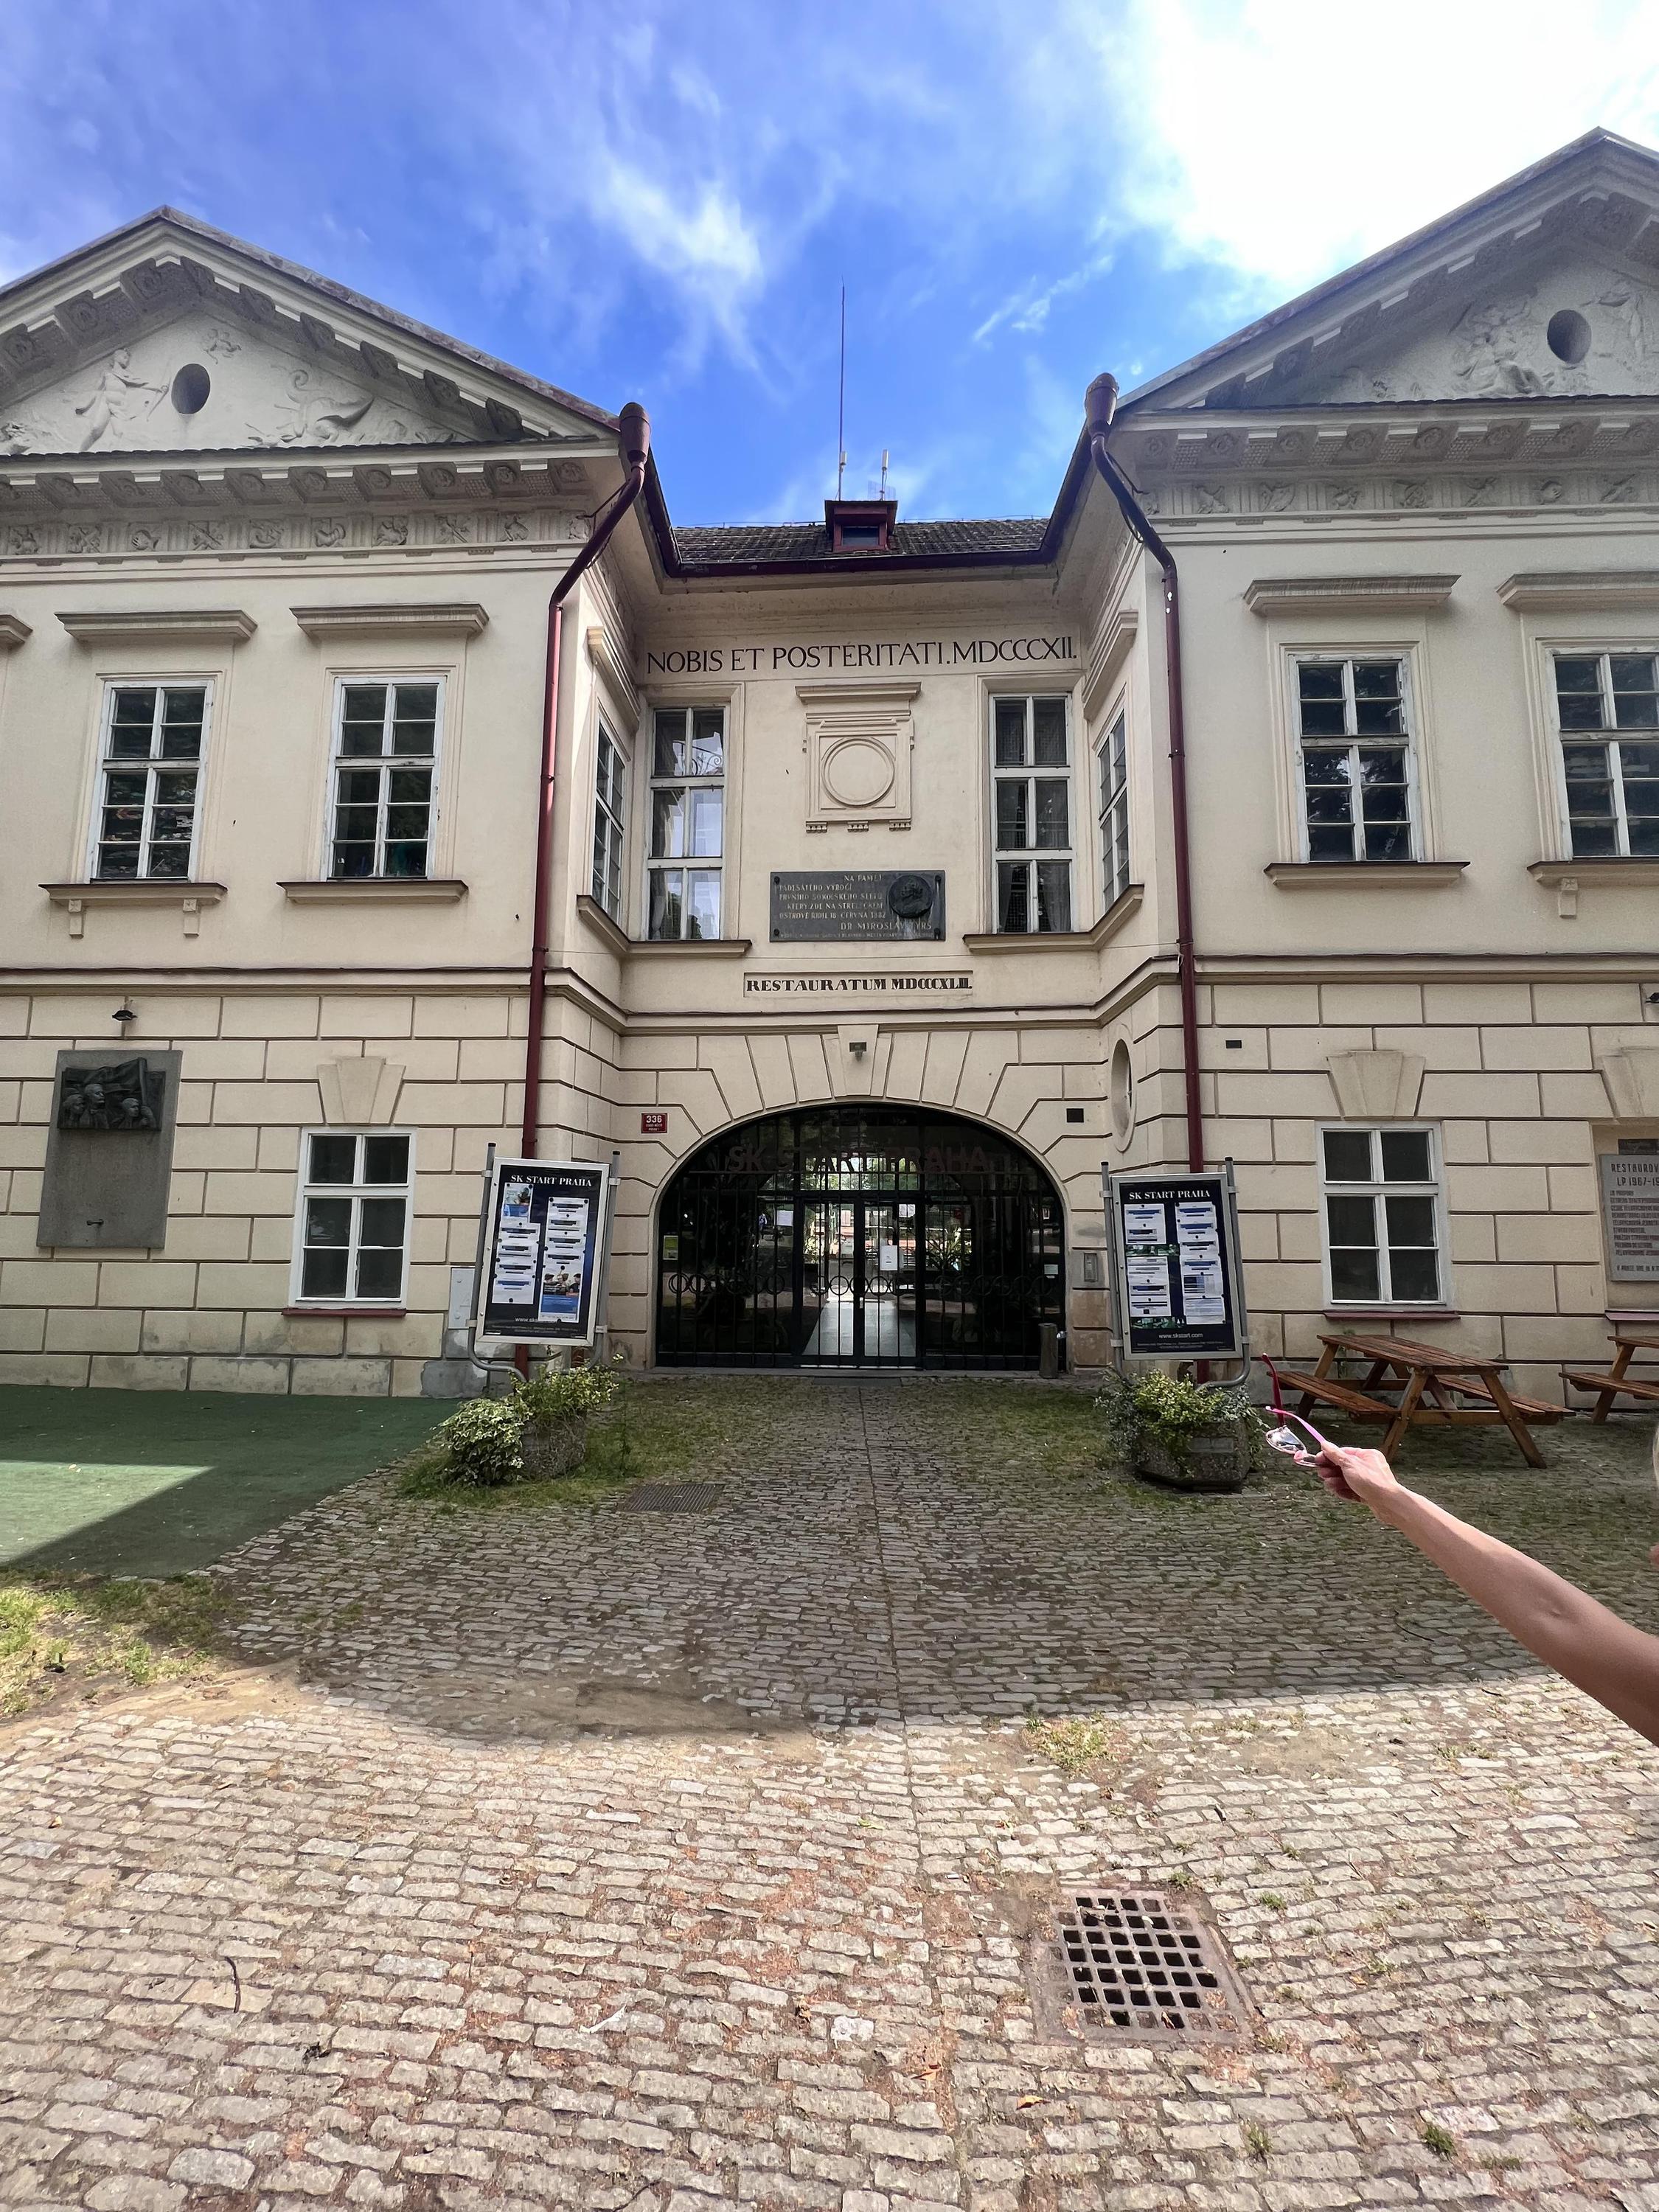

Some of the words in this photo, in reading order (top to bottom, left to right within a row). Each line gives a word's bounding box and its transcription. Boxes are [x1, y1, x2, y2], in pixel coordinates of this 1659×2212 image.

[647, 650, 723, 674] NOBIS
[731, 648, 765, 671] ET
[746, 978, 887, 992] RESTAURATUM
[646, 1115, 662, 1124] 336
[1610, 1163, 1659, 1173] RESTAUROV
[511, 1174, 524, 1183] SK
[526, 1175, 557, 1185] START
[559, 1177, 592, 1187] PRAHA
[1129, 1192, 1142, 1200] SK
[1144, 1191, 1175, 1200] START
[1178, 1189, 1211, 1198] PRAHA
